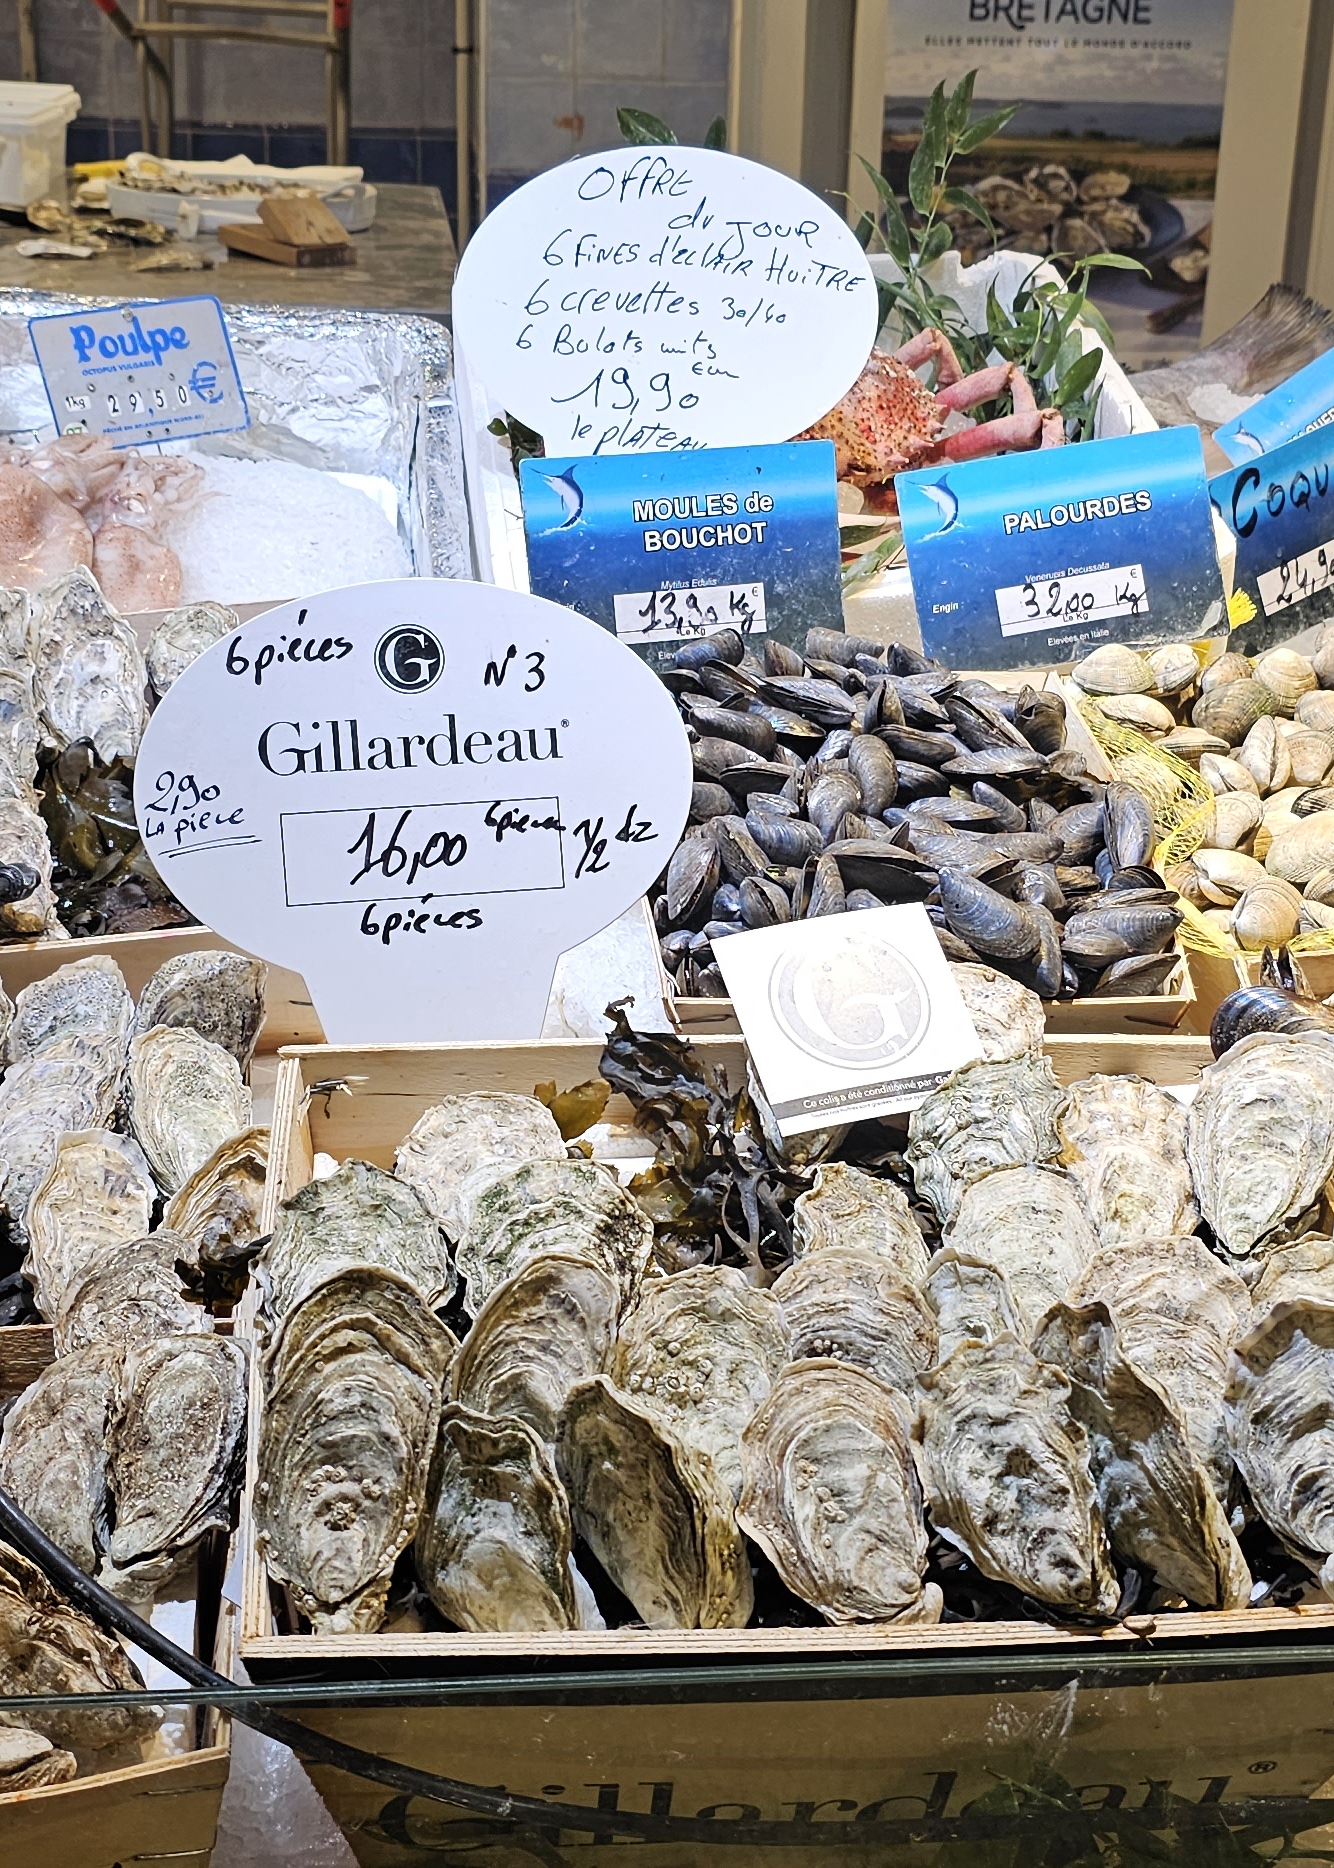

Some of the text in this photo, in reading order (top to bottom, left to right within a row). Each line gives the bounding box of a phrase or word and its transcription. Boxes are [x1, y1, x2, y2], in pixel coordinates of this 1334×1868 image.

[969, 0, 1152, 30] BRETAGNE
[542, 229, 564, 267] 6
[524, 278, 550, 316] 6
[69, 316, 190, 366] Poulpe
[515, 324, 532, 350] 6
[82, 364, 117, 377] OCTOPUS
[188, 361, 223, 404] €
[550, 365, 700, 415] 19,90
[632, 490, 775, 523] MOULES de
[1003, 490, 1153, 536] PALOURDES
[643, 521, 768, 553] BOUCHOT
[660, 577, 718, 592] Mytilus Edulis
[1025, 560, 1110, 584] Venerupis Decussata
[931, 600, 960, 614] Engin
[1091, 628, 1110, 640] Italie
[524, 651, 547, 692] 3
[346, 808, 468, 886] 16,00
[803, 1100, 817, 1109] Ce
[847, 1090, 863, 1099] été
[917, 1079, 932, 1090] par
